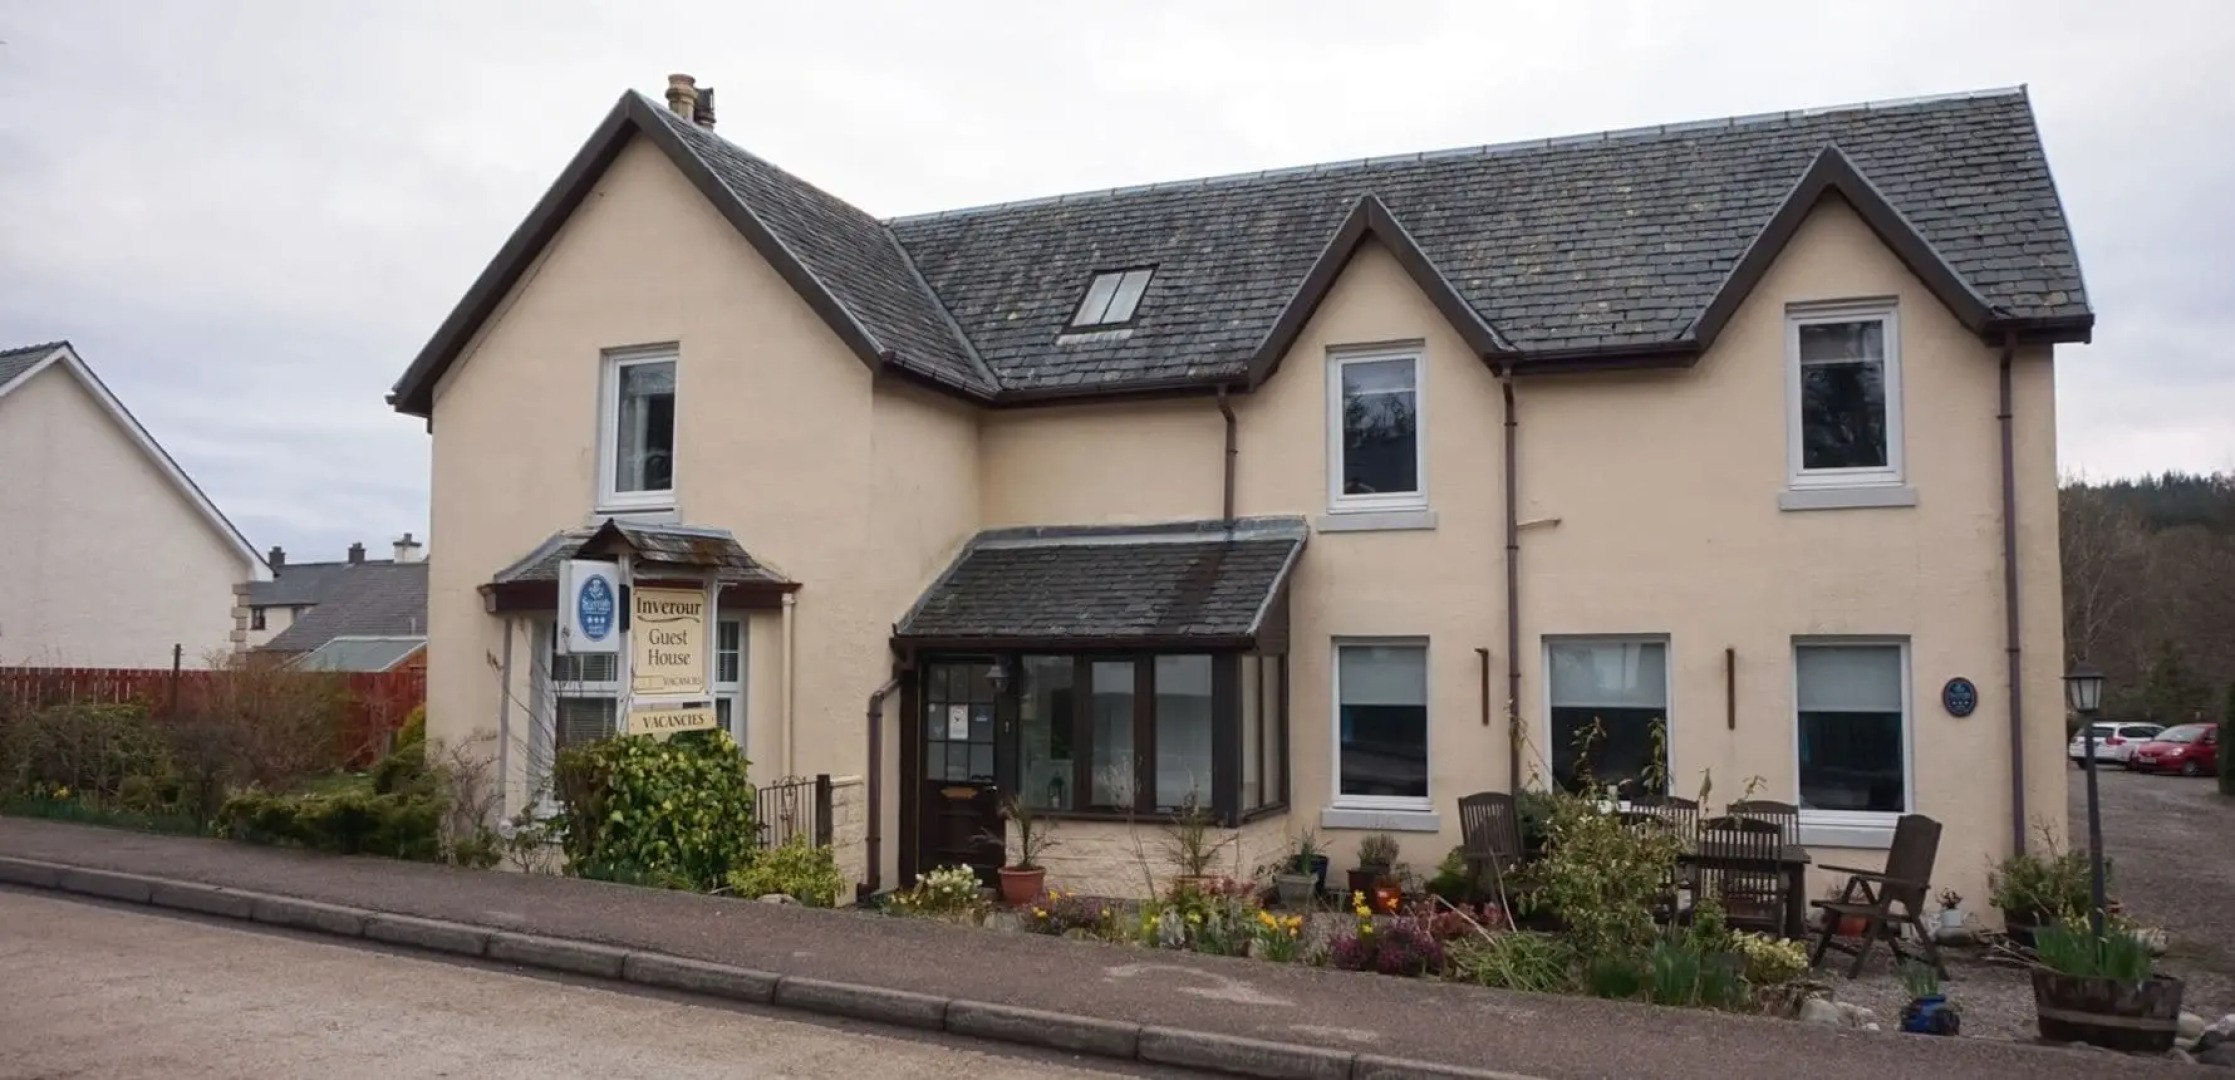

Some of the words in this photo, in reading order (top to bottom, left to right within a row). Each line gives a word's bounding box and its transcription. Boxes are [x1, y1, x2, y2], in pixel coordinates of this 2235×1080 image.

[637, 597, 701, 616] Inverour
[649, 629, 688, 645] Guest
[648, 648, 691, 666] House
[643, 713, 704, 729] VACANCIES
